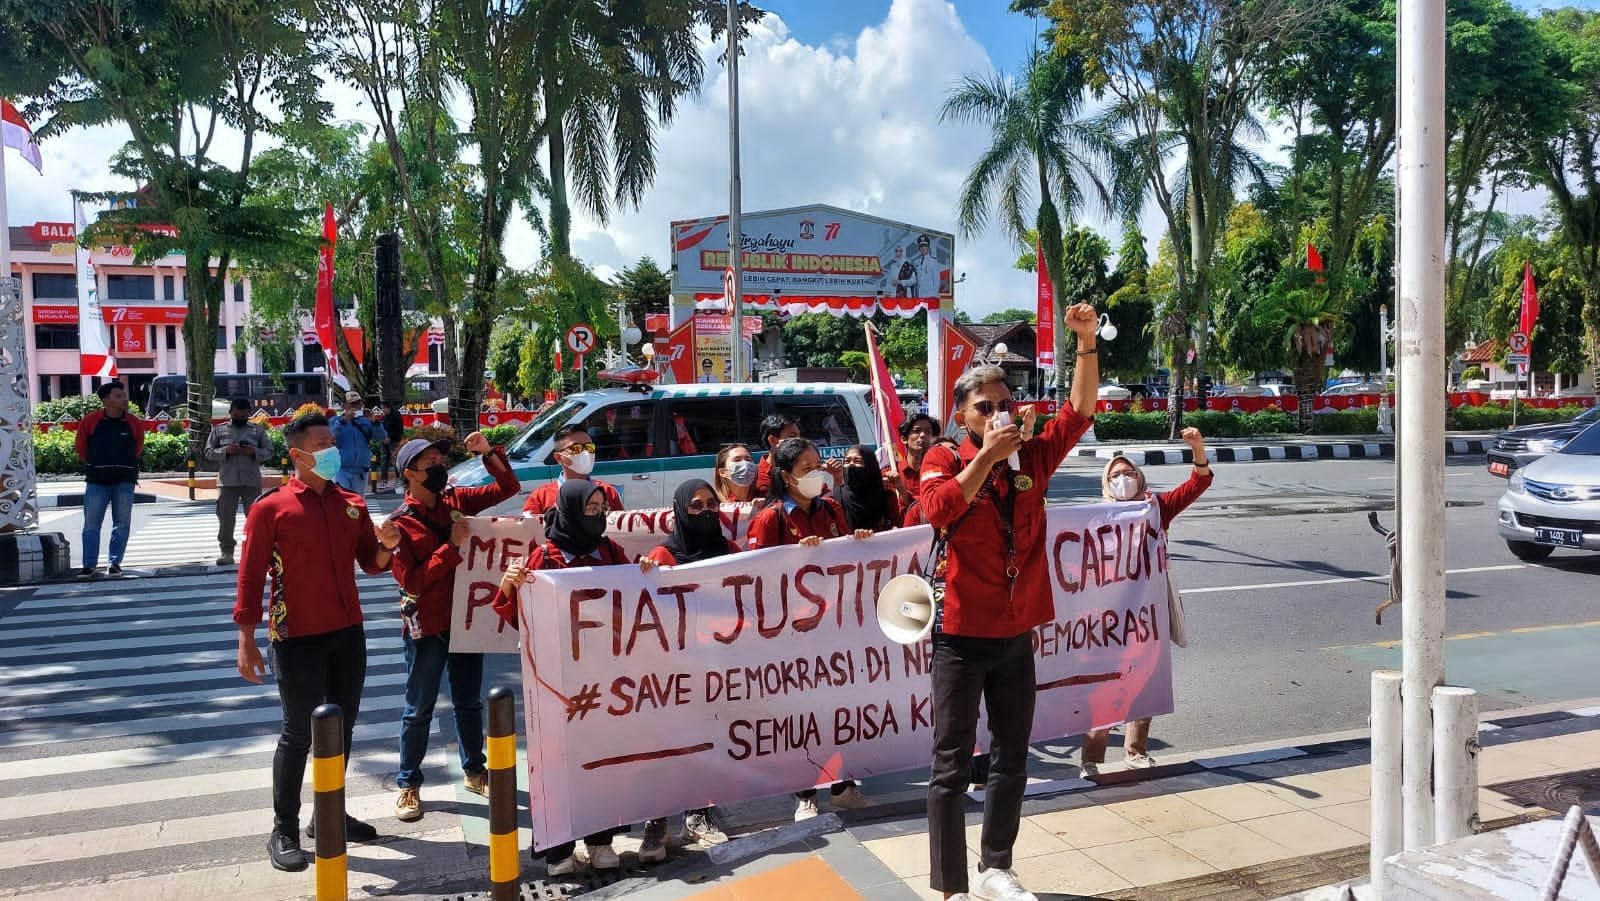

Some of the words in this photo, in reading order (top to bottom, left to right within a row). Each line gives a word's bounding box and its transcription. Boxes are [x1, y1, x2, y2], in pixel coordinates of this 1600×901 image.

[41, 225, 75, 238] BALA
[824, 222, 841, 241] 77
[704, 250, 787, 270] REUBLIK
[791, 253, 881, 273] INDONESIA
[744, 274, 765, 282] LEBIH
[792, 276, 824, 285] BANGKIT
[825, 277, 845, 285] LEBIH
[670, 344, 685, 360] 77
[951, 344, 964, 360] 77
[570, 584, 700, 661] FIAT
[705, 650, 855, 703] DEMOKRASI
[866, 645, 890, 683] DI
[728, 712, 821, 760] SEMUA
[833, 701, 899, 745] BISA
